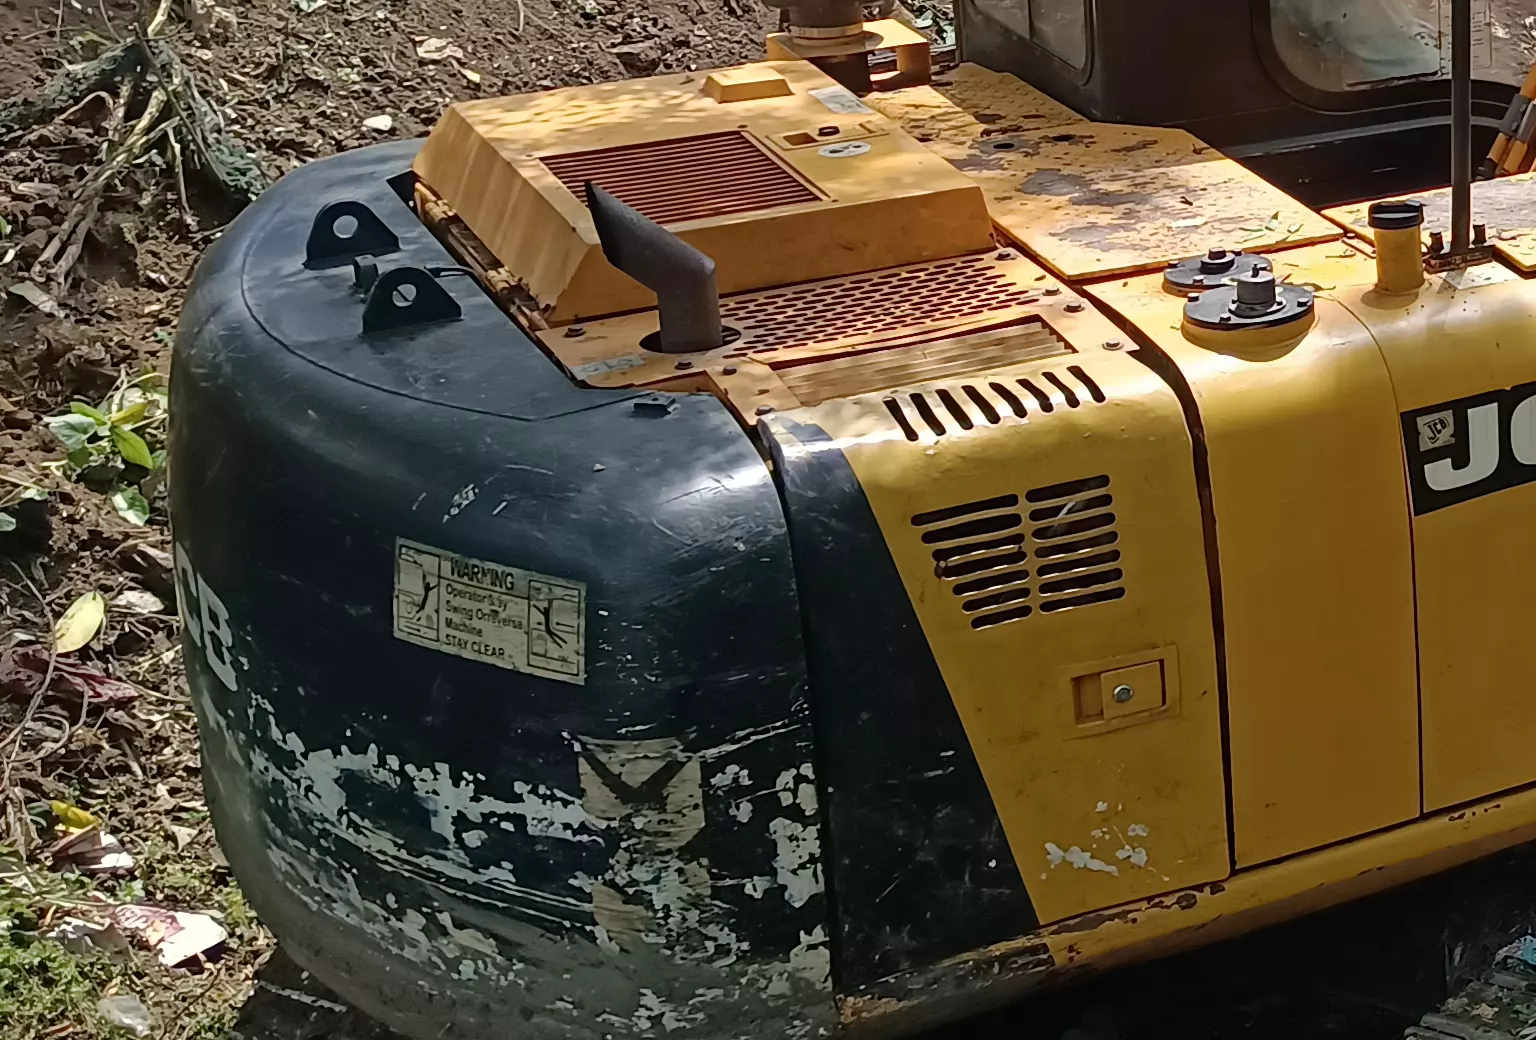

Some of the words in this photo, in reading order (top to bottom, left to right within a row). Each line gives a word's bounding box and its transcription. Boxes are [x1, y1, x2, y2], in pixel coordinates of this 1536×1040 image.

[1424, 416, 1448, 443] JCB
[445, 616, 483, 638] Machine
[445, 633, 468, 649] STAY
[471, 641, 506, 661] CLEAR
